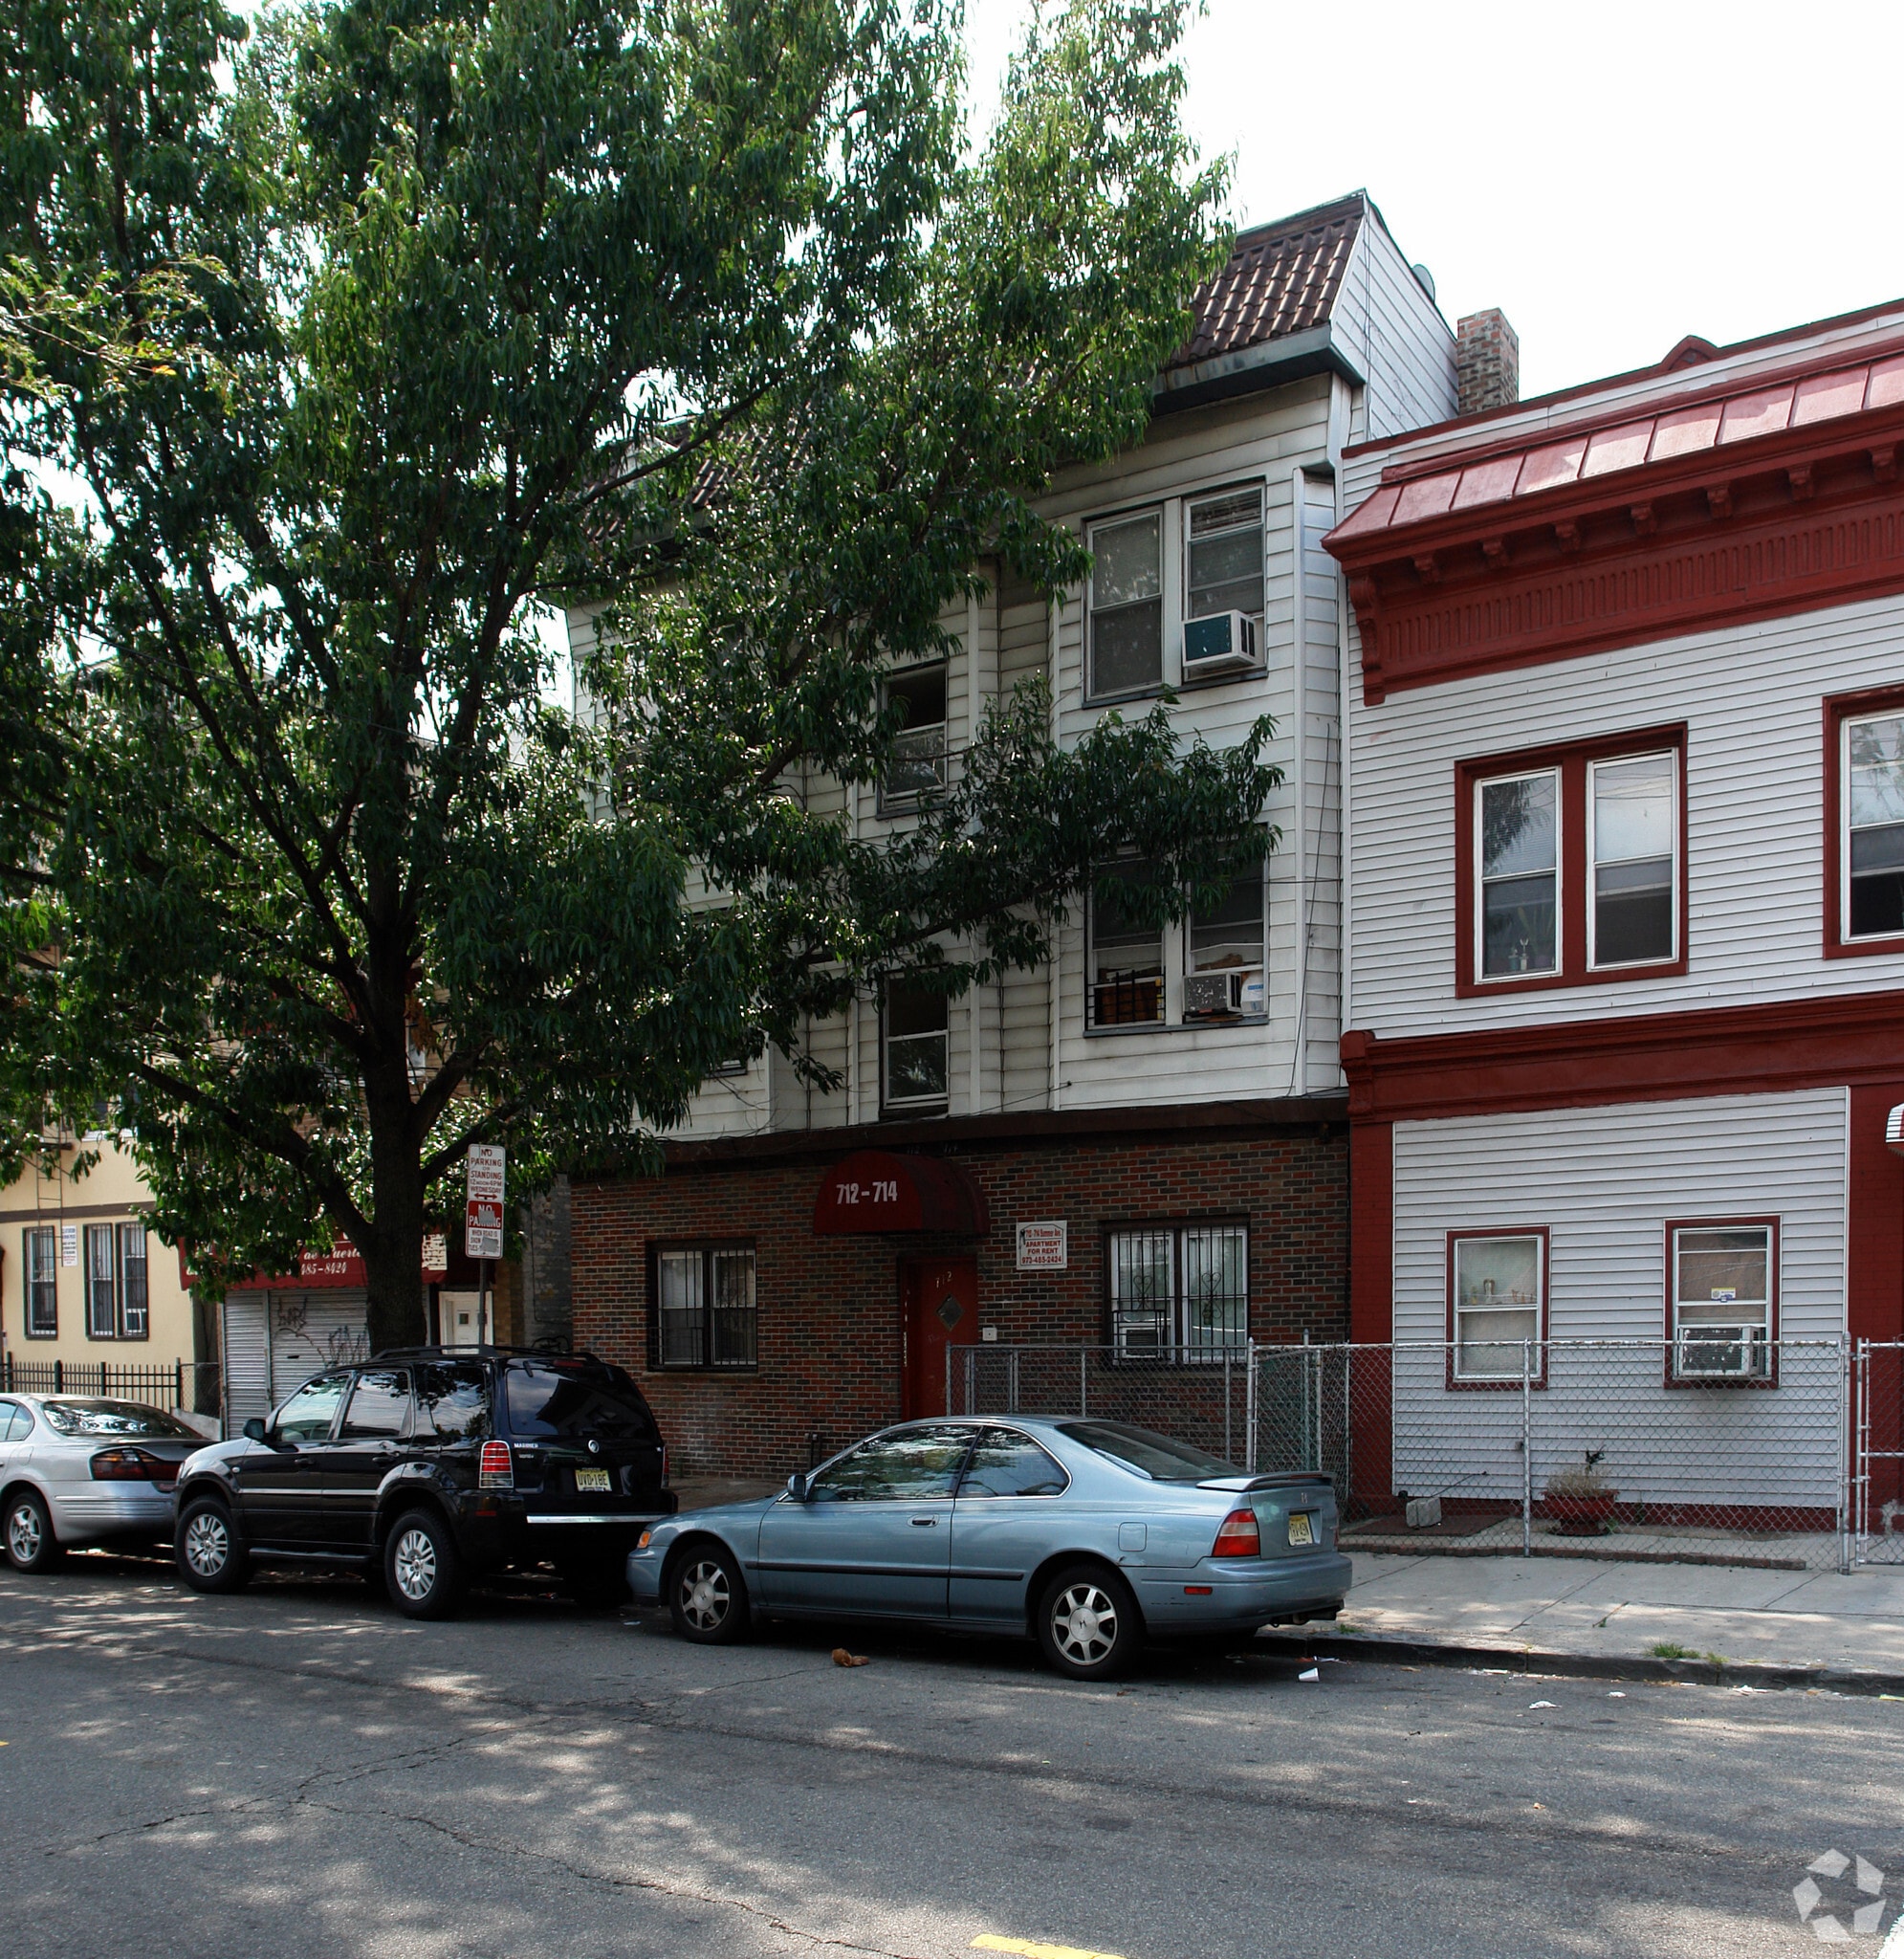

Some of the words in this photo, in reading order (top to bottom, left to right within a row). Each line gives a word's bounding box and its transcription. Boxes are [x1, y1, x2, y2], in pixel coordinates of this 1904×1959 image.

[471, 1157, 502, 1167] PARKING
[471, 1171, 502, 1179] STANDING
[835, 1180, 898, 1204] 712-714
